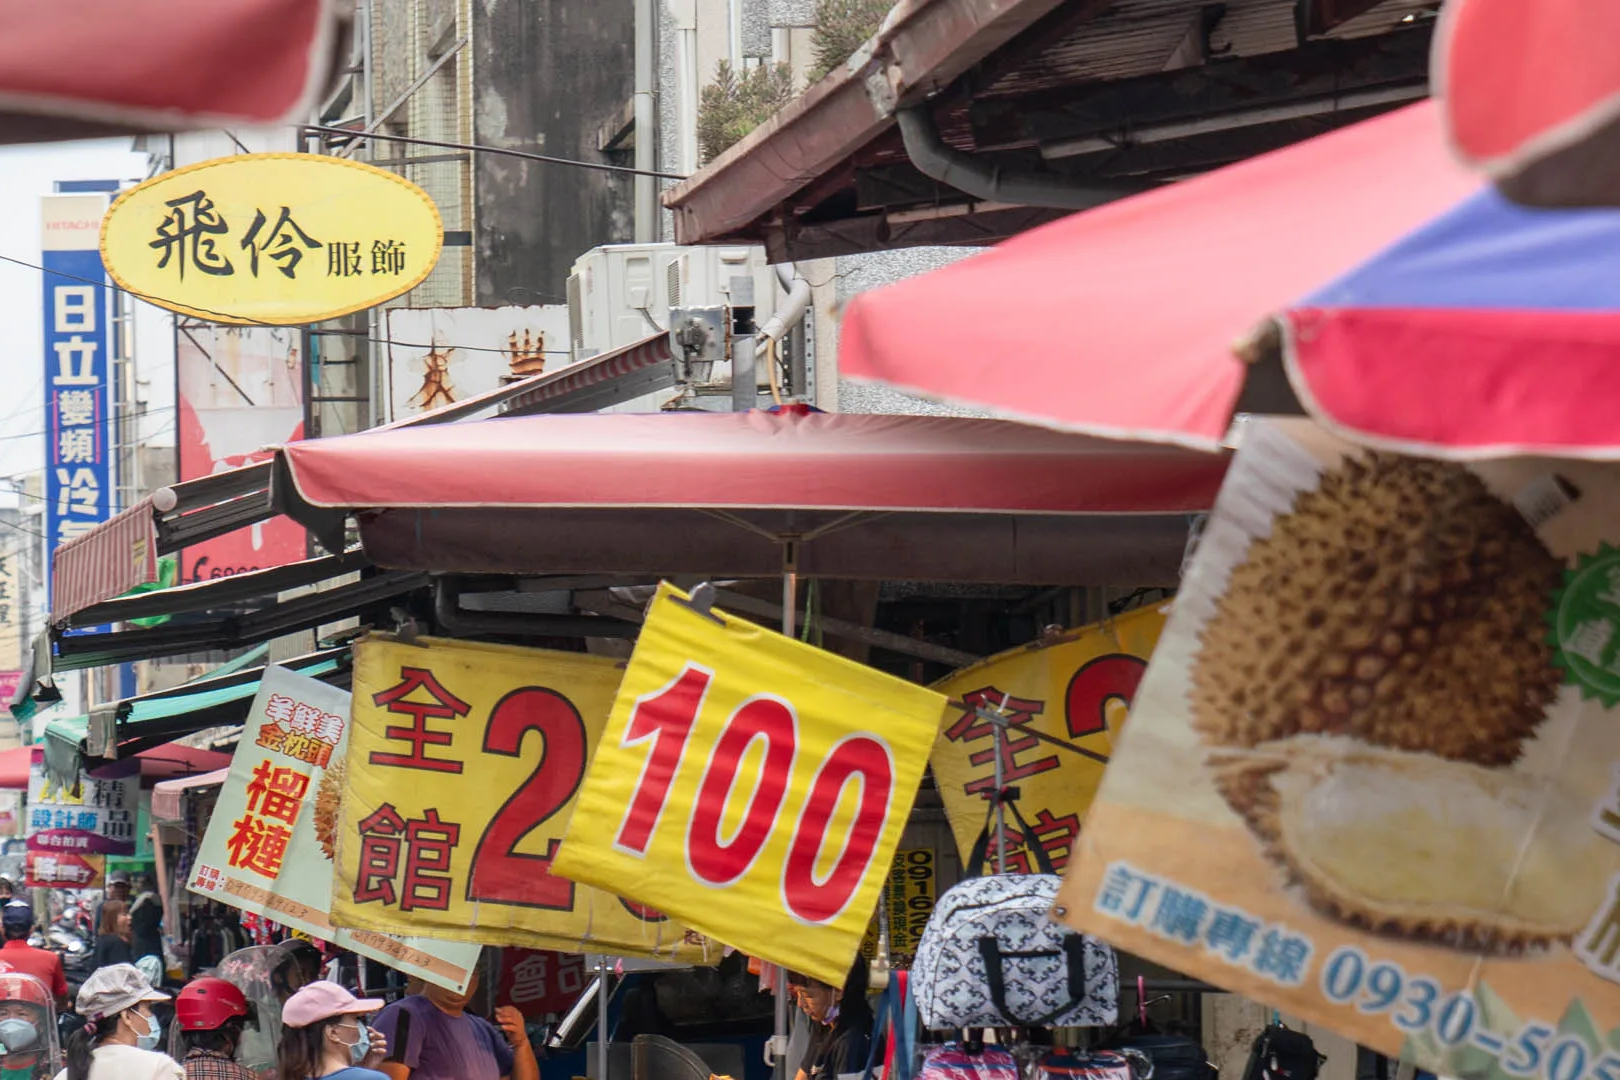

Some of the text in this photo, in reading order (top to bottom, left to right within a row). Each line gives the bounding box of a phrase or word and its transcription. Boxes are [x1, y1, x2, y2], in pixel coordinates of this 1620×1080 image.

[148, 188, 407, 282] 飛伶服飾
[255, 723, 335, 770] 金枕頭
[352, 665, 473, 914] 全館
[616, 660, 897, 926] 100
[31, 808, 99, 831] 設計師
[226, 759, 312, 880] 榴槤
[1096, 862, 1312, 984] 訂購專線
